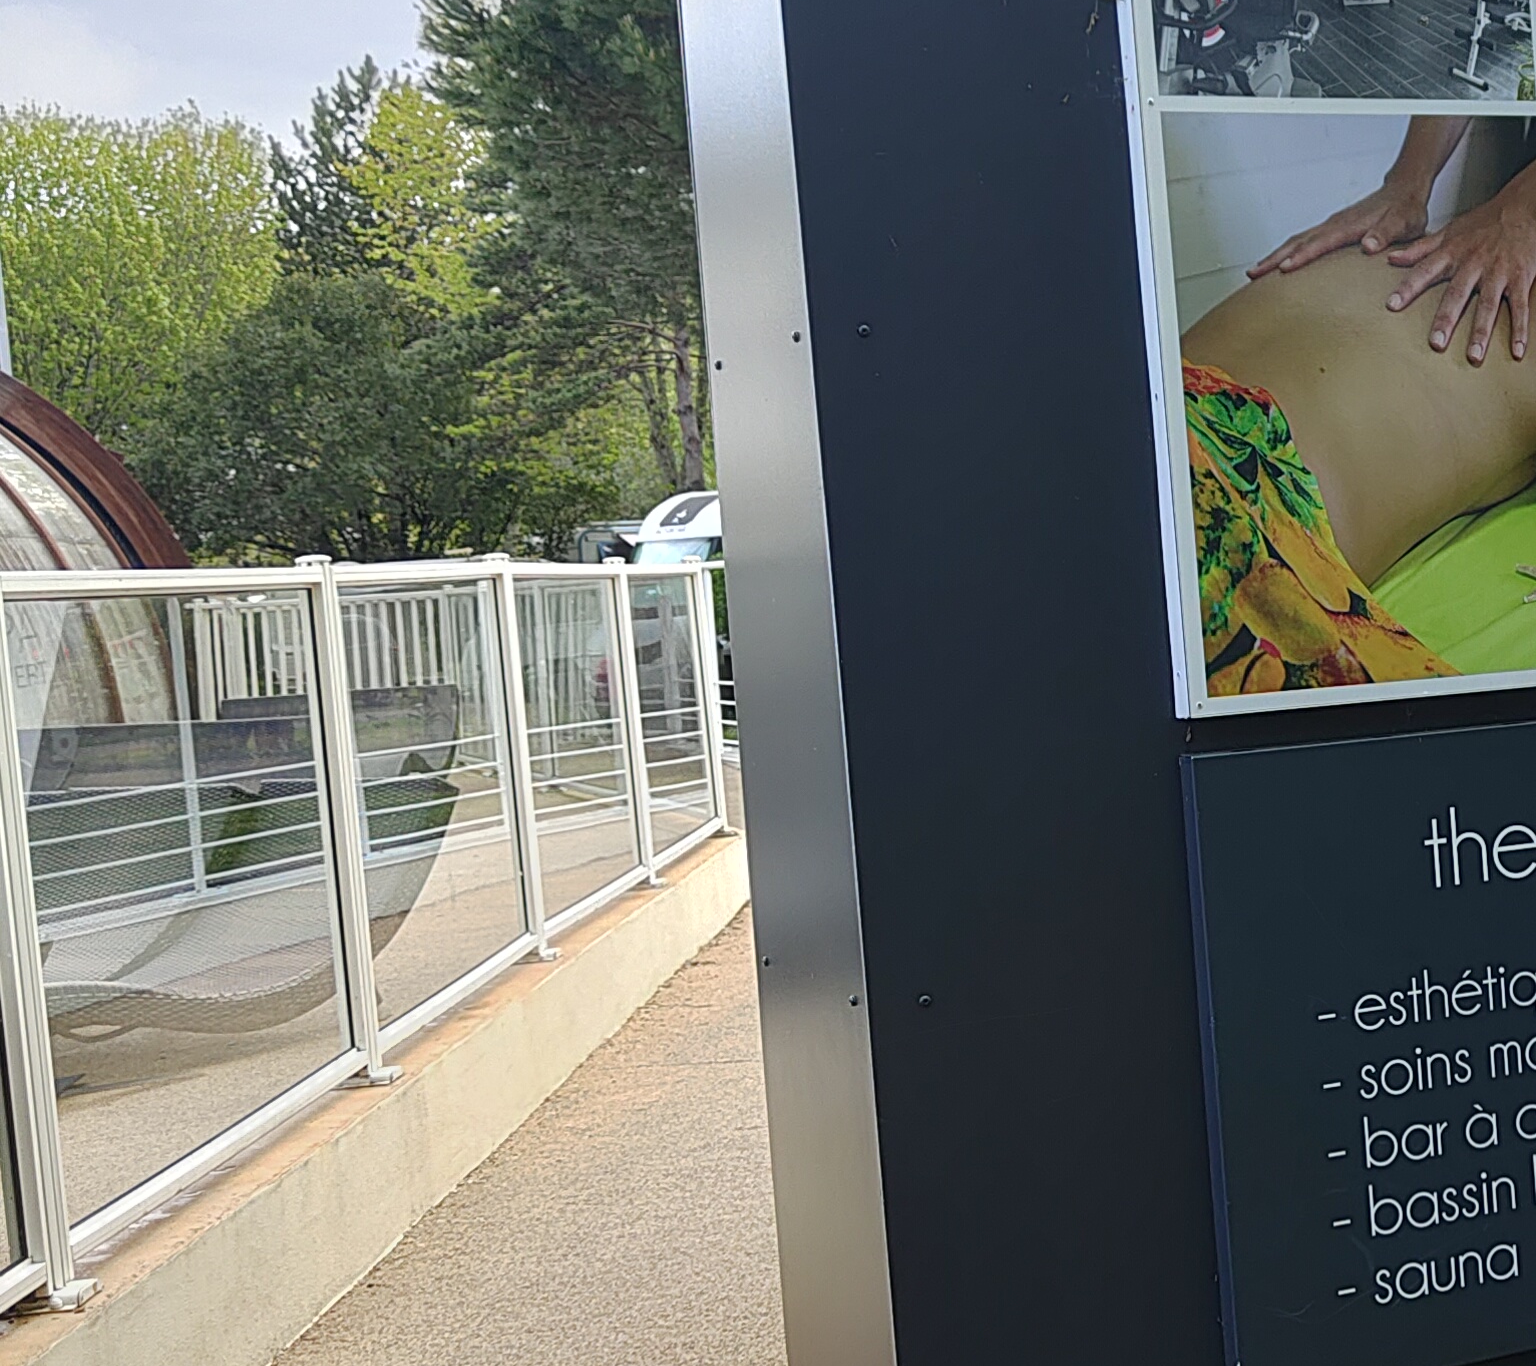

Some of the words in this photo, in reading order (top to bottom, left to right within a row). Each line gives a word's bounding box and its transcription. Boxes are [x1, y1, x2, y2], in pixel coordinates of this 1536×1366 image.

[1360, 1047, 1472, 1099] soins
[1363, 1116, 1448, 1169] bar
[1465, 1103, 1499, 1149] à
[1368, 1171, 1517, 1237] bassin
[1374, 1244, 1519, 1304] sauna
